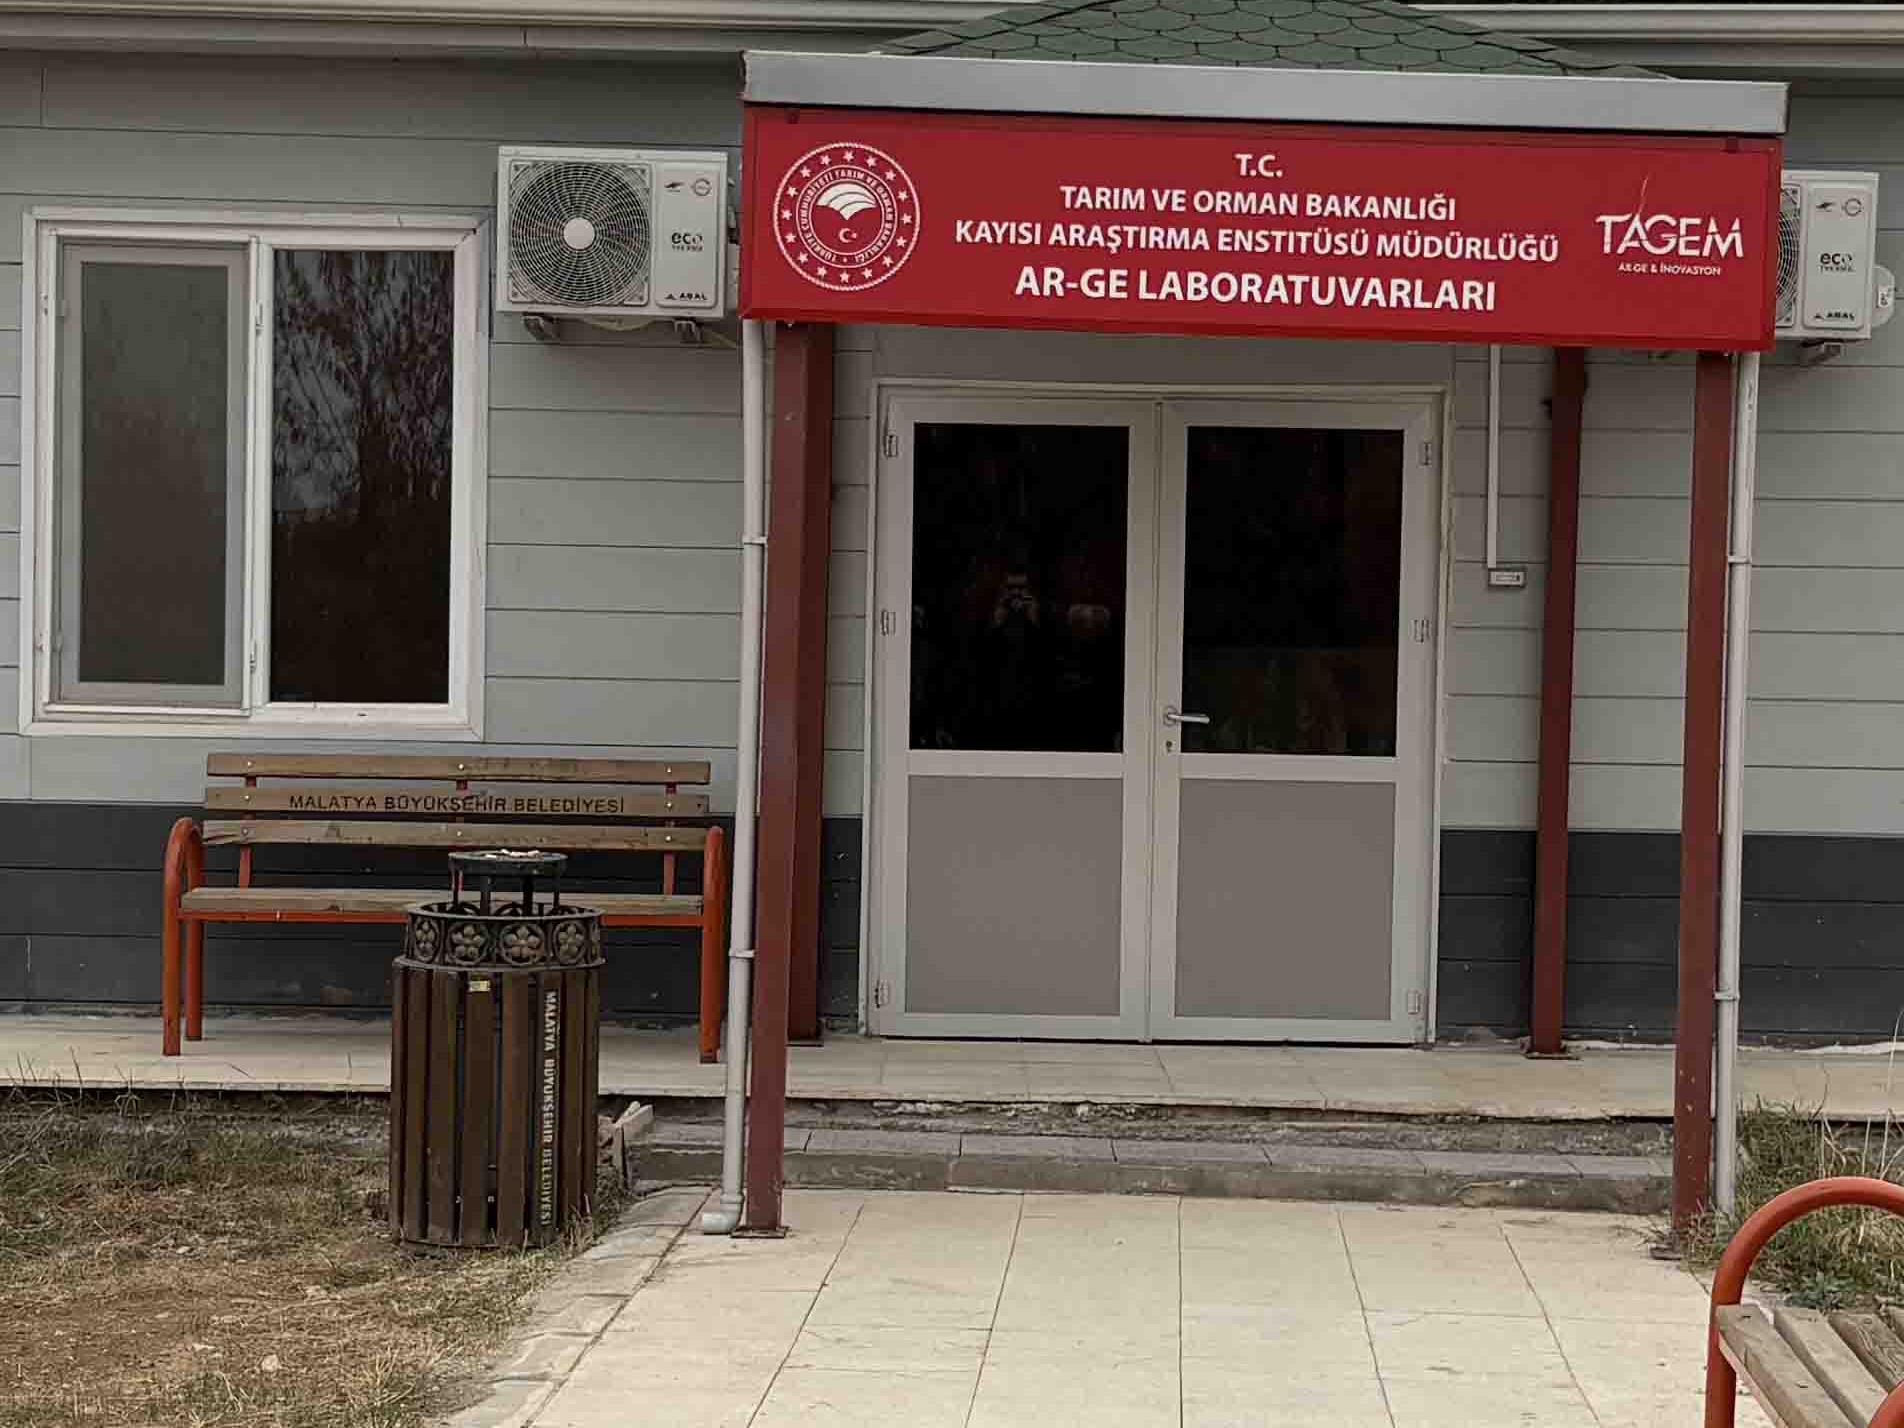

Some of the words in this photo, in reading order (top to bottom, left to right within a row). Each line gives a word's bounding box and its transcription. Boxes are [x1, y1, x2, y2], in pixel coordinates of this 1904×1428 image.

[1235, 154, 1283, 178] T.C.
[1059, 185, 1145, 210] TARIM
[1152, 189, 1186, 212] VE
[1193, 190, 1297, 216] ORMAN
[1305, 192, 1456, 221] BAKANLIĞI
[955, 220, 1041, 245] KAYISI
[1048, 223, 1210, 254] ARAŞTIRMA
[1376, 230, 1559, 262] MÜDÜRLÜĞÜ
[1595, 212, 1745, 259] TAGEM
[1015, 266, 1128, 299] AR-GE
[1138, 269, 1496, 312] LABORATUVARLARI
[289, 795, 377, 810] MALATYA
[544, 990, 557, 1052] MALATYA
